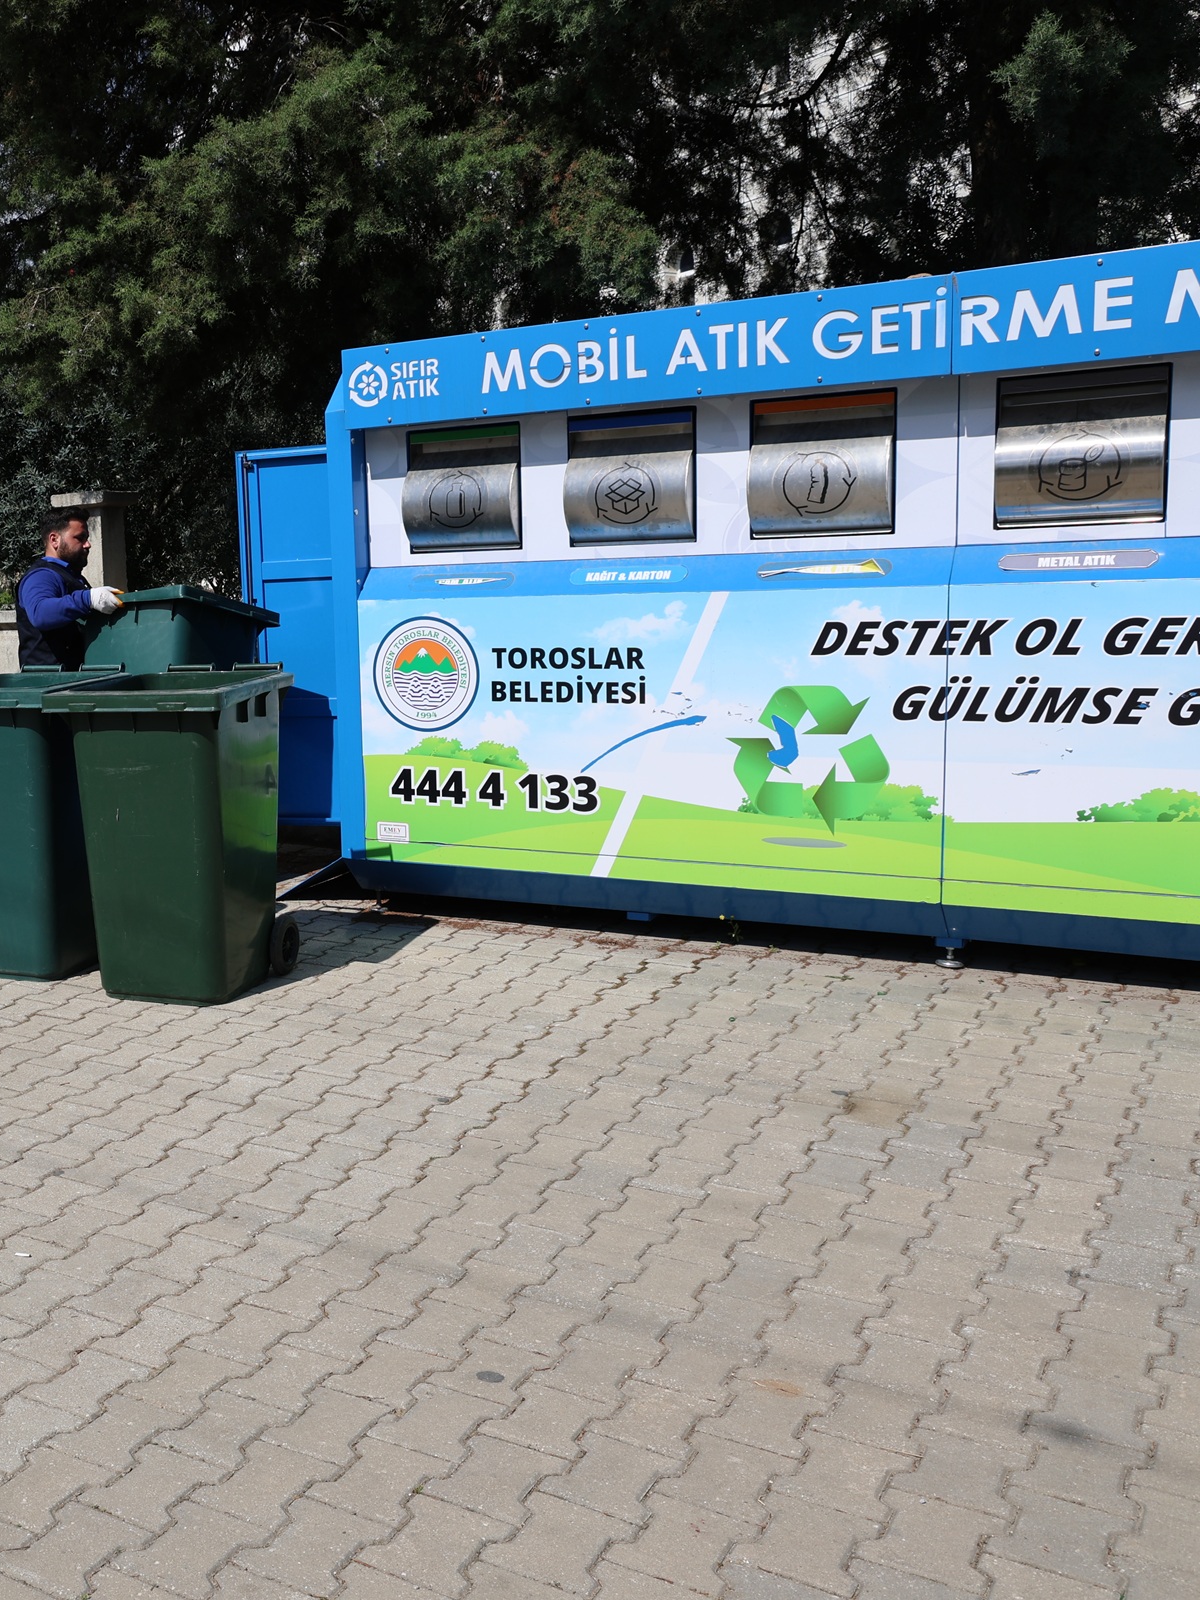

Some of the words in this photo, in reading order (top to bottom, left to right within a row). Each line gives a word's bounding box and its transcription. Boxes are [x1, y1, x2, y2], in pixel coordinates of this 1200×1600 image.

[481, 327, 647, 394] MOBİL
[665, 317, 790, 376] ATIK
[812, 275, 1134, 360] GETİRME
[390, 358, 439, 381] SIFIR
[392, 377, 440, 400] ATIK
[1037, 555, 1083, 568] METAL
[1083, 554, 1116, 567] ATIK
[585, 569, 617, 583] KAĞIT
[618, 571, 628, 582] &
[627, 570, 672, 582] KARTON
[394, 629, 440, 650] TOROSLAR
[811, 619, 1008, 656] DESTEK
[1015, 617, 1086, 656] OL
[491, 647, 645, 670] TOROSLAR
[491, 675, 646, 704] BELEDİYESİ
[892, 676, 1159, 725] GÜLÜMSE
[391, 768, 467, 805] 444
[478, 772, 504, 807] 4
[518, 773, 598, 812] 133
